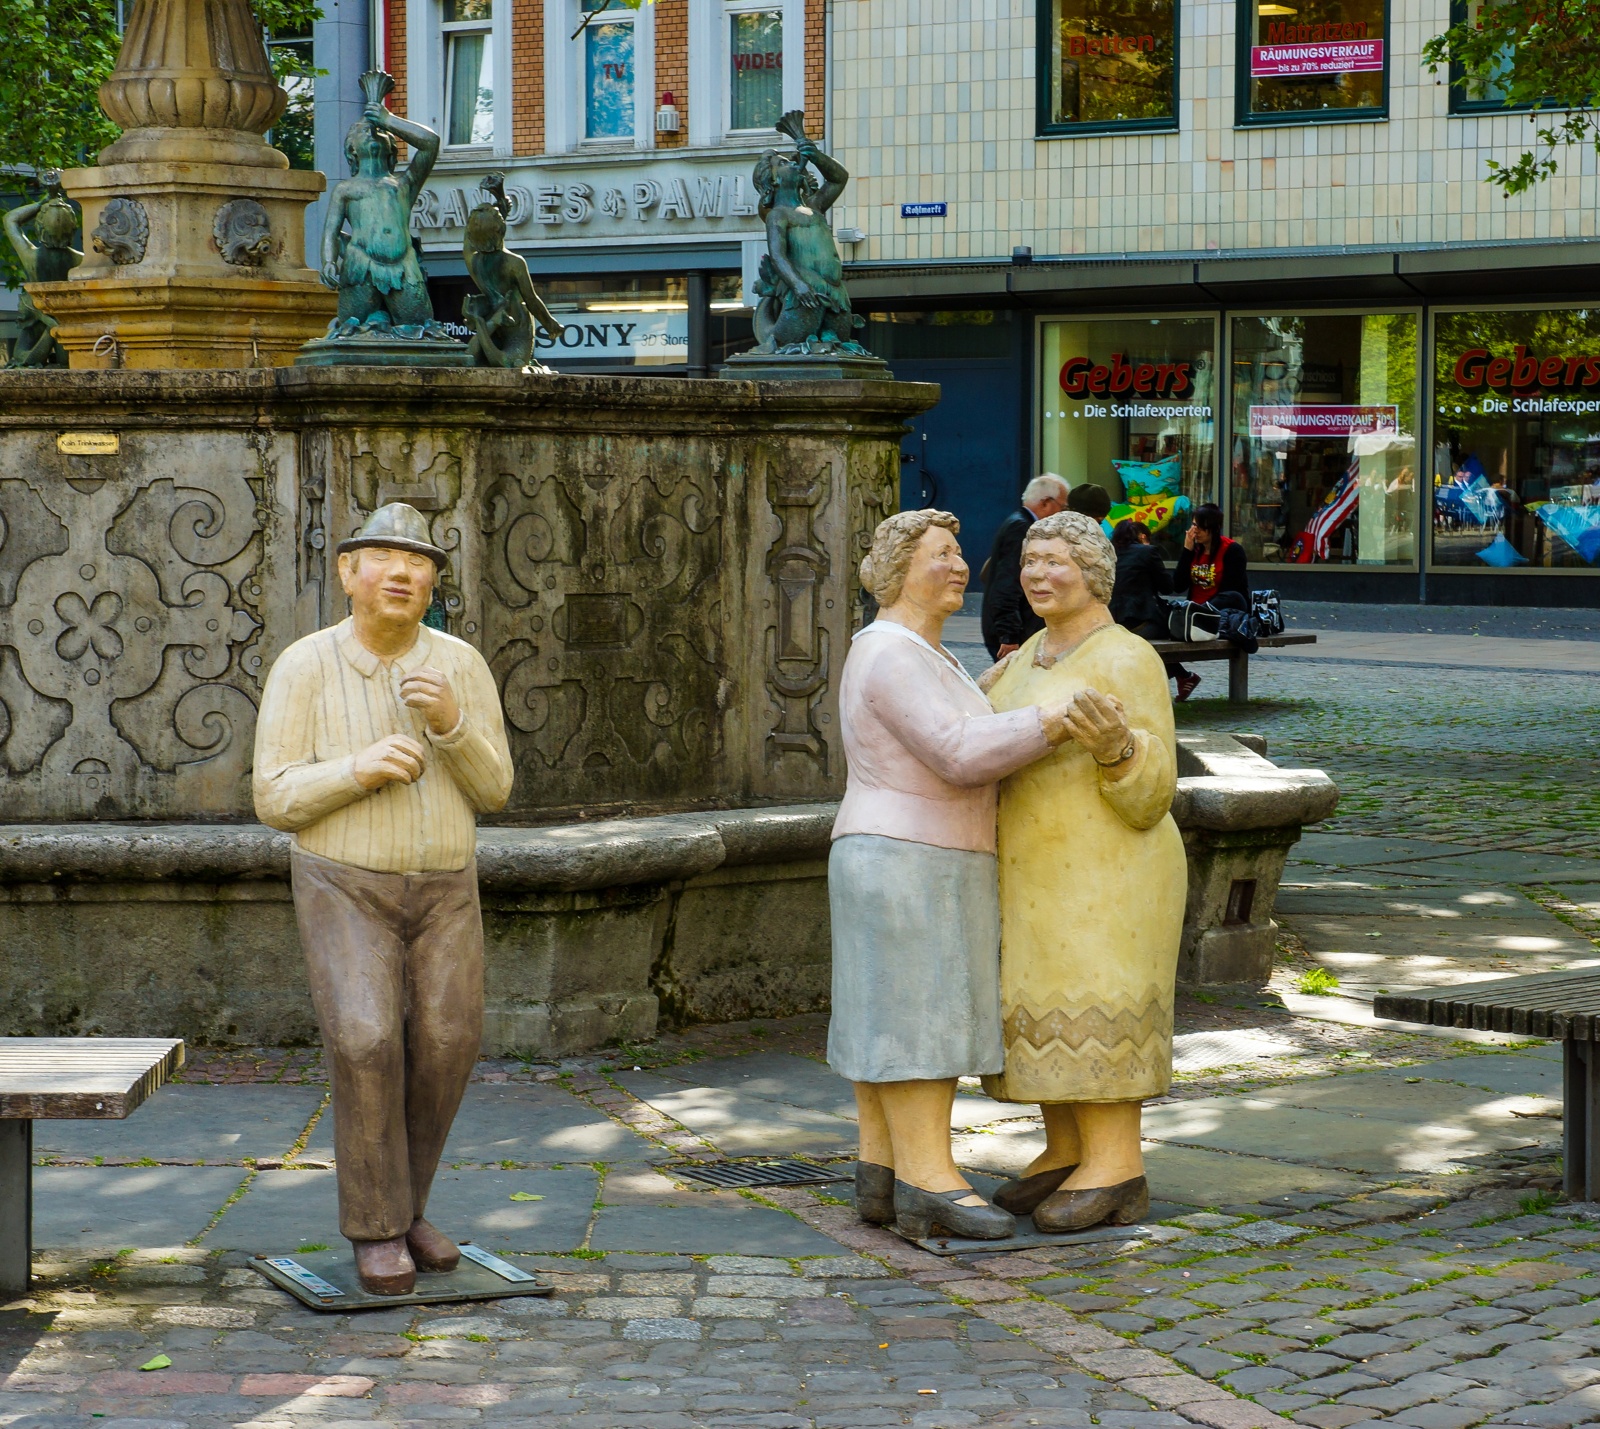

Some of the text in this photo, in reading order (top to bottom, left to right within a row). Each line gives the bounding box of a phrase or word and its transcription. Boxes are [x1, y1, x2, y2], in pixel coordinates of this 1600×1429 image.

[1267, 20, 1368, 44] Matratzen
[1070, 34, 1154, 56] Betten
[1260, 44, 1375, 61] RÄUMUNGSVERKAUF
[603, 63, 625, 79] TV
[1278, 61, 1354, 72] bis zu 70% reduziert
[535, 323, 688, 349] SONY 3D Store
[1059, 352, 1193, 397] Gebers
[1454, 344, 1600, 390] Gebers
[1084, 404, 1107, 418] Die
[1110, 404, 1211, 420] Schlafexperten
[1483, 398, 1508, 413] Die
[1252, 412, 1395, 426] 70% RÄUMUNGSVERKAUF 70%
[78, 439, 115, 447] Trinkwasser
